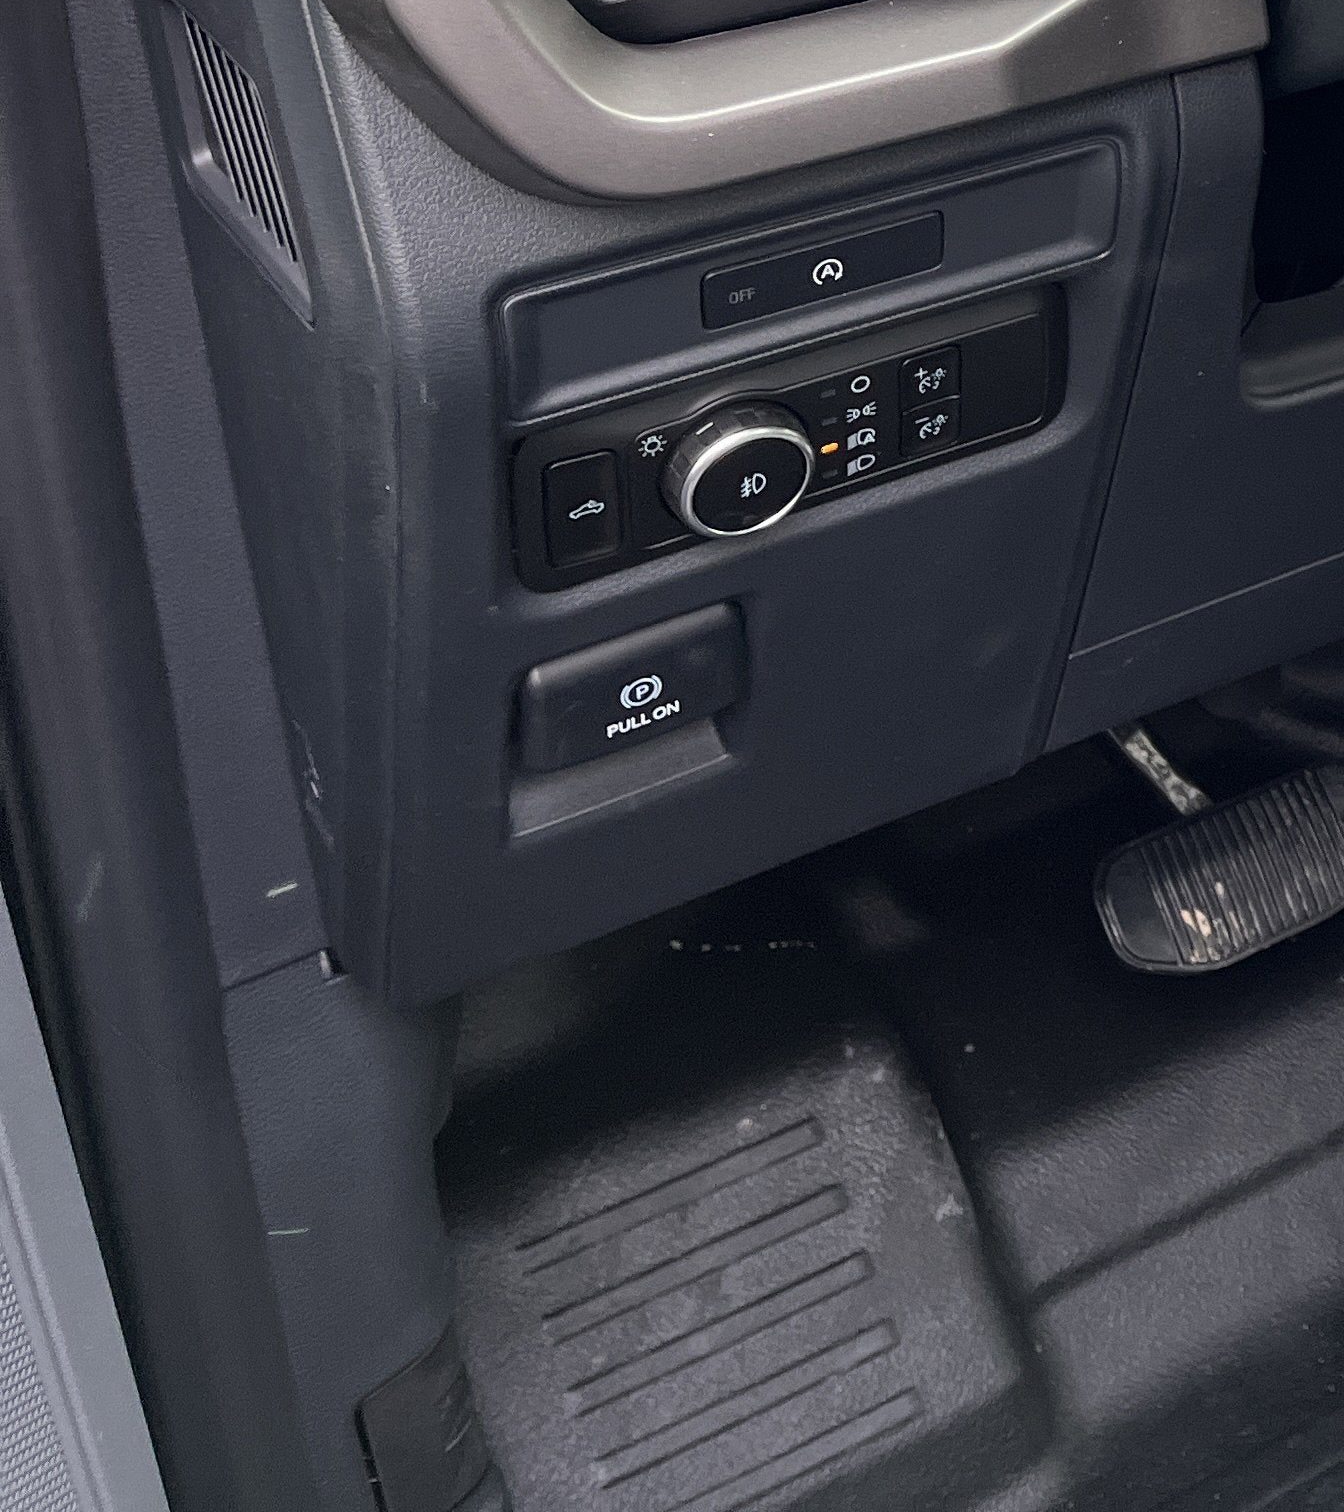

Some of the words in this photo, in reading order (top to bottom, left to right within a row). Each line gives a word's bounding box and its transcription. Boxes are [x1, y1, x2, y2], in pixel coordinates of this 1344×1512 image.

[728, 287, 756, 305] OFF
[606, 714, 652, 739] PULL
[652, 700, 680, 721] ON
